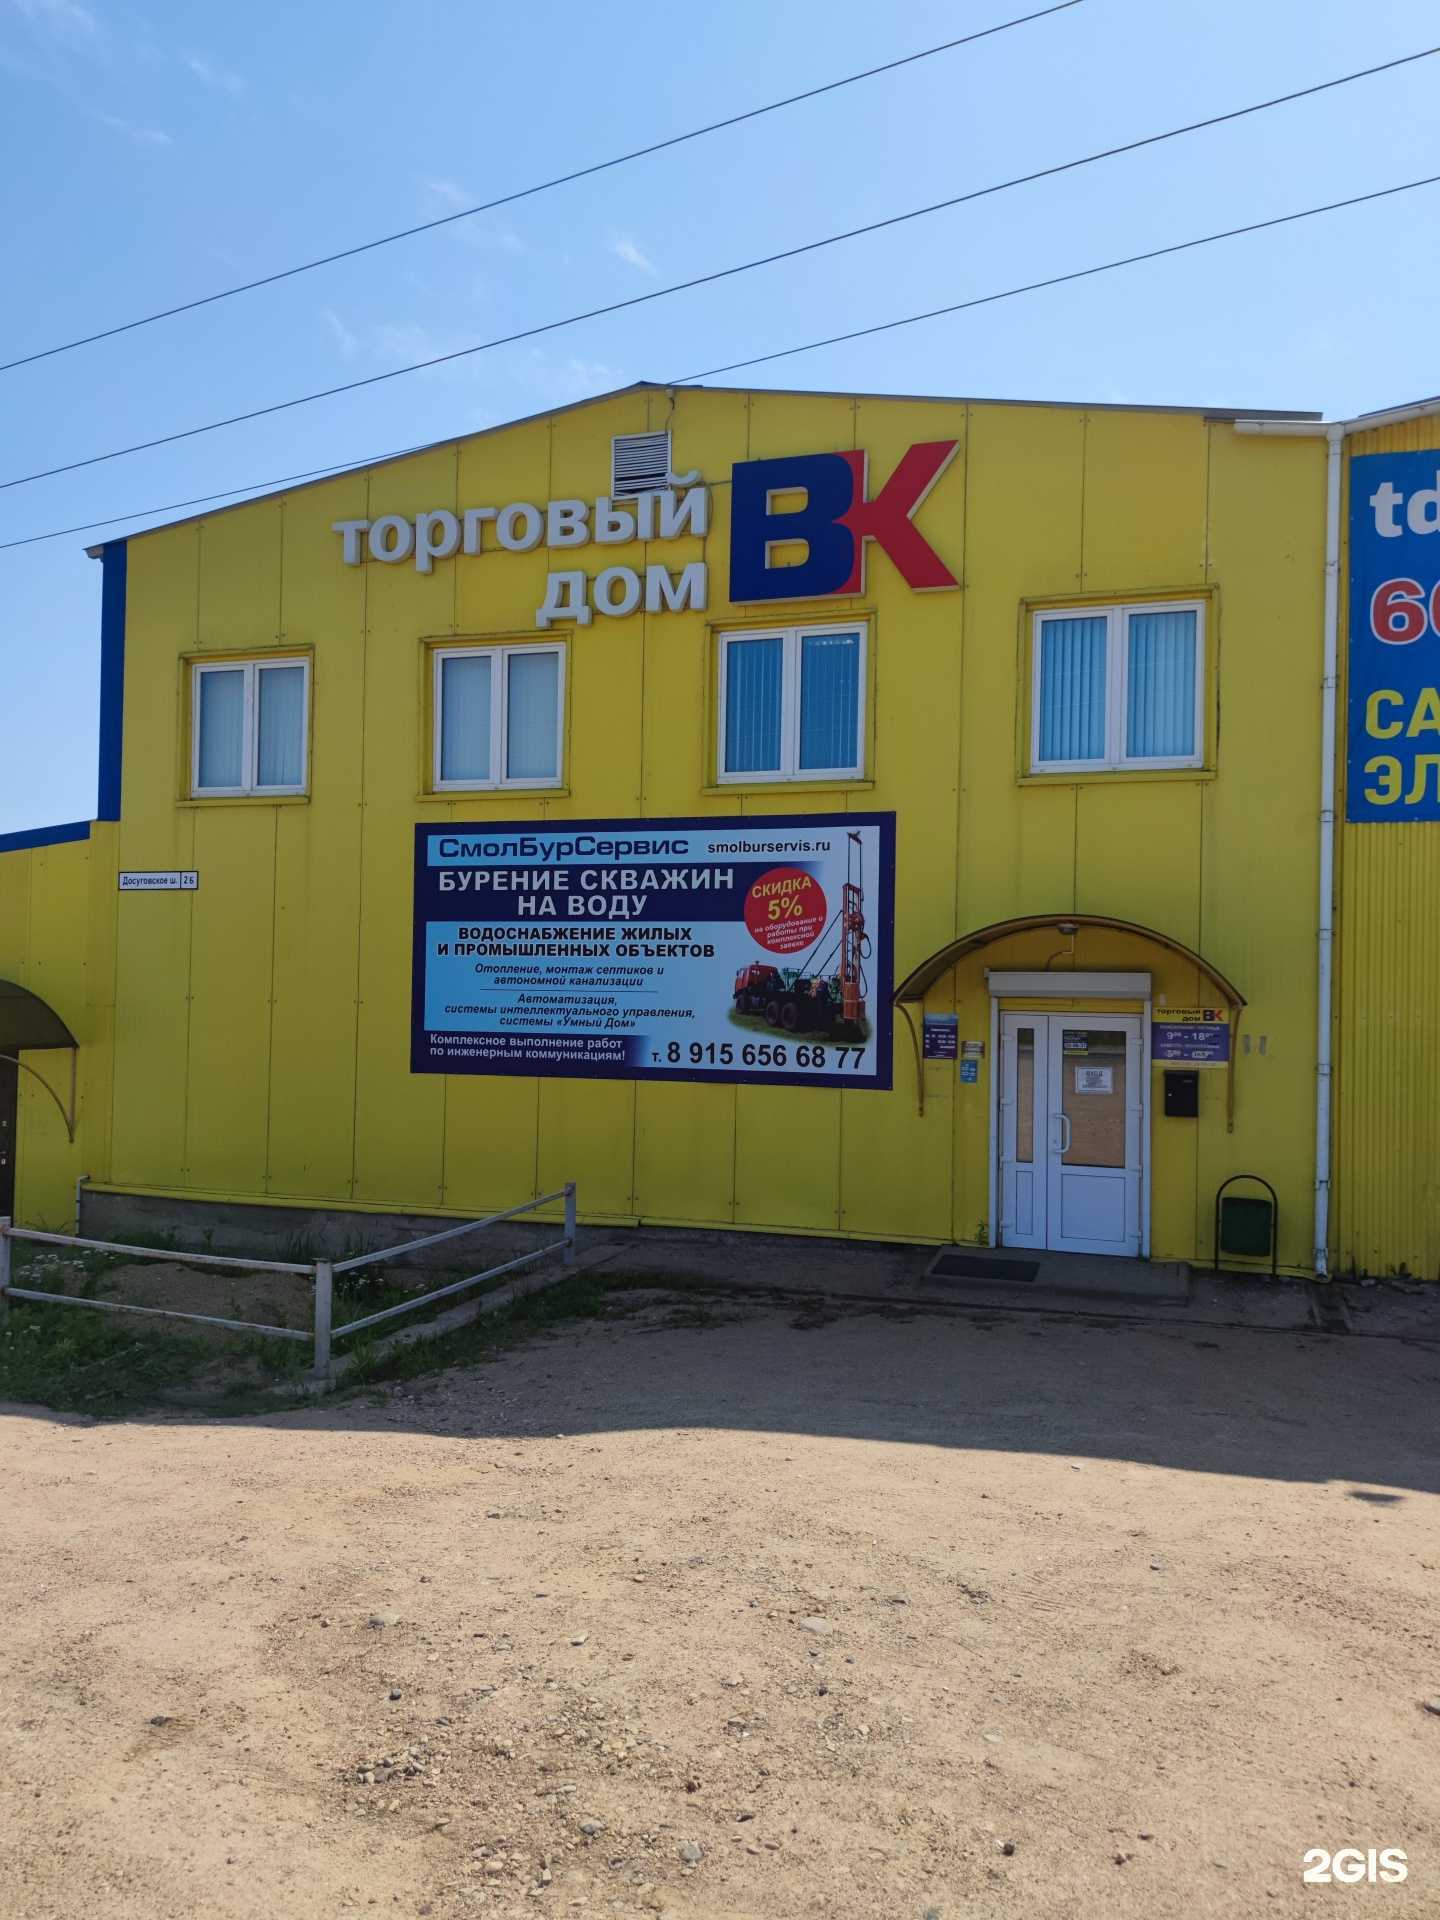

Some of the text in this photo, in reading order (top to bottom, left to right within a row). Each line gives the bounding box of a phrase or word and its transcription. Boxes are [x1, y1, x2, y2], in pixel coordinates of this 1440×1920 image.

[332, 469, 709, 574] торговый
[729, 439, 960, 606] ВК
[536, 562, 709, 629] дом
[1370, 577, 1440, 645] 6
[439, 836, 689, 862] СмолБурСервис
[707, 840, 831, 854] smolburservis.ru
[439, 868, 734, 892] БУРЕНИЕ СКВАЖИН
[752, 876, 812, 898] СКИДКА
[517, 894, 648, 920] НА ВОДУ
[768, 894, 803, 920] 5%
[458, 927, 692, 941] ВОДОСНАБЖЕНИЕ ЖИЛЫХ
[437, 943, 715, 958] И ПРОМЫШЛЕННЫХ ОБЪЕКТОВ
[474, 963, 664, 975] Отопление, монтаж септиков и
[493, 976, 644, 988] автономной канализации
[517, 993, 618, 1006] Автоматизация,
[444, 1005, 696, 1020] системы интеллектуального управления,
[499, 1017, 553, 1026] системы
[604, 1018, 636, 1029] Дом»
[430, 1033, 623, 1050] Комплексное выполнение работ
[430, 1047, 626, 1062] по инженерным коммуникациям!
[651, 1041, 866, 1069] т. 8 915 656 68 77
